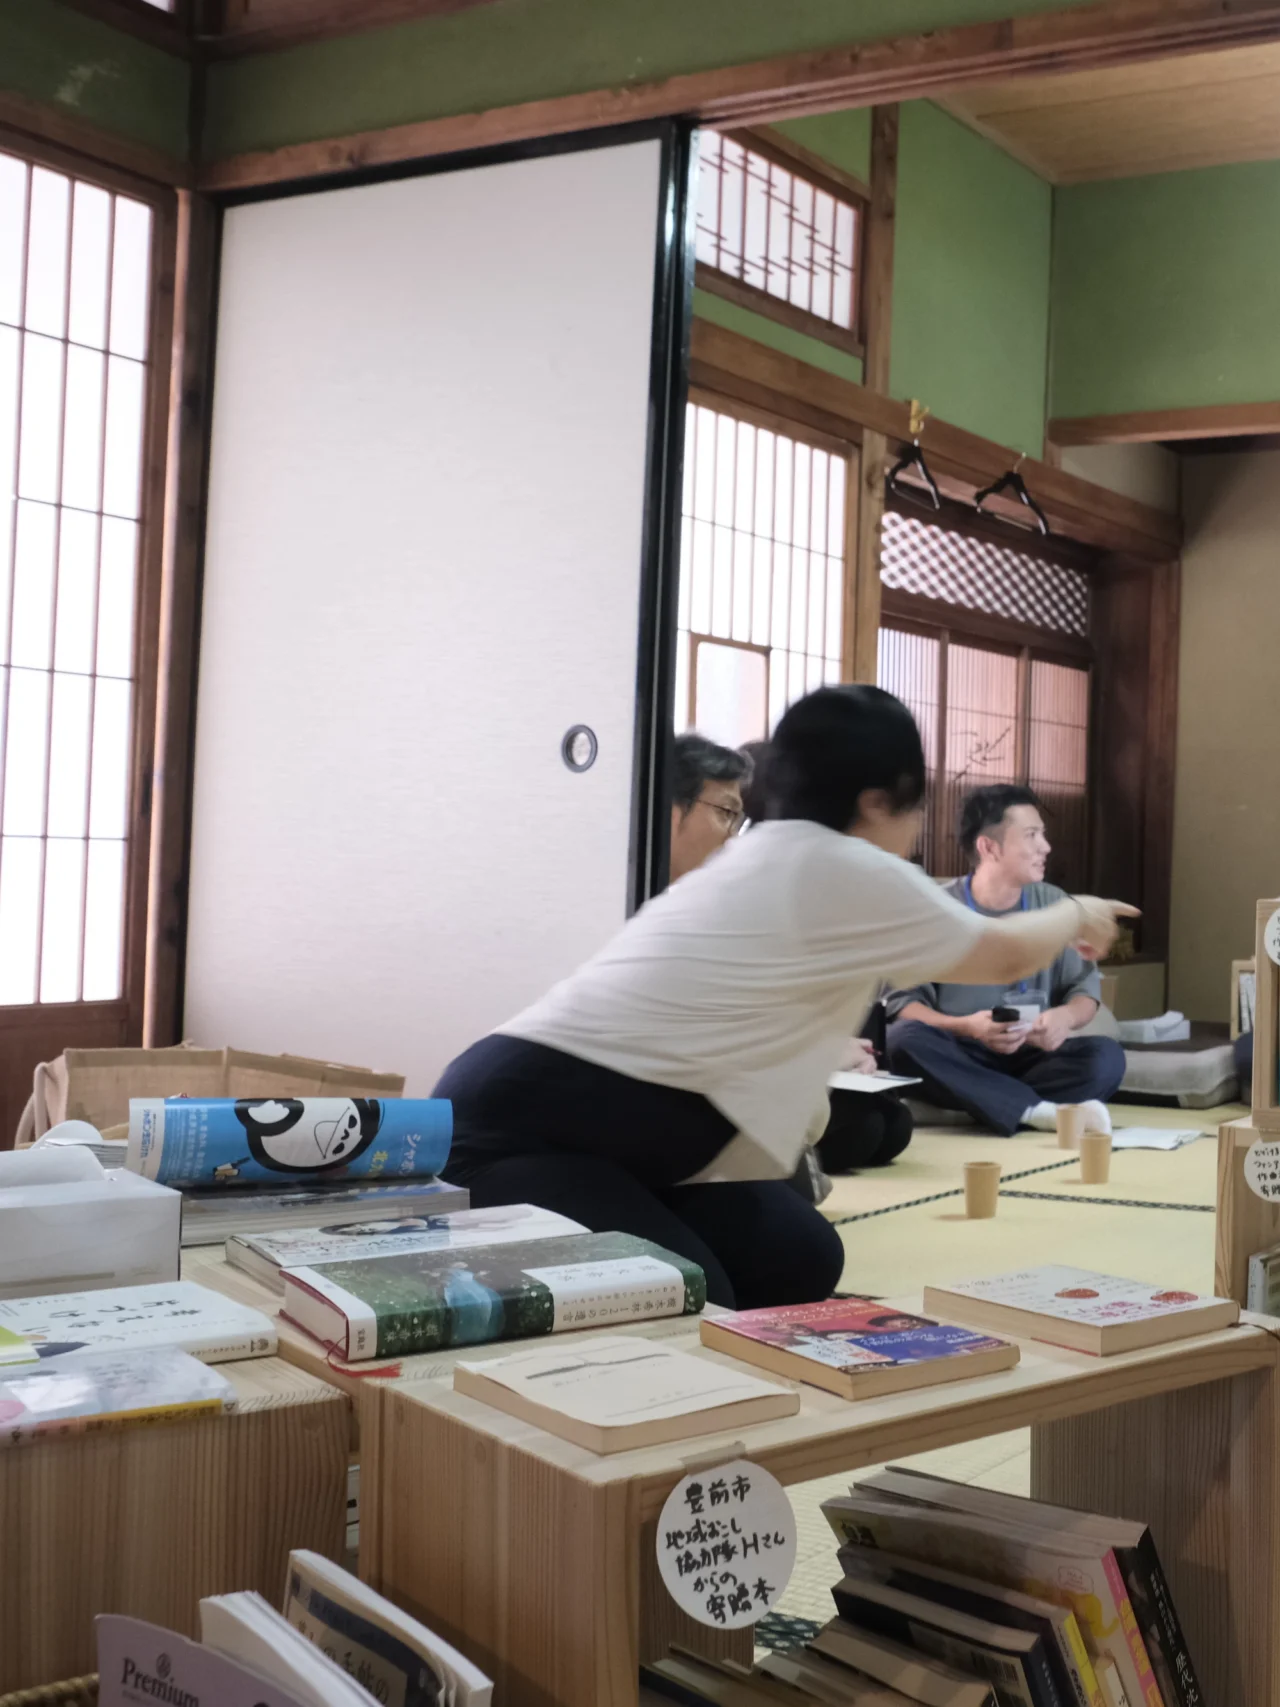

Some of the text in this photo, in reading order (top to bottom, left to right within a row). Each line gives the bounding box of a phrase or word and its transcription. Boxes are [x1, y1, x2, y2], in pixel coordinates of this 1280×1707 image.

[384, 1323, 439, 1343] 樹木希林
[684, 1475, 752, 1514] 豊前市
[665, 1517, 742, 1550] 地域おこし
[693, 1571, 737, 1593] からの
[706, 1577, 776, 1624] 寄贈本
[121, 1657, 200, 1707] Premium
